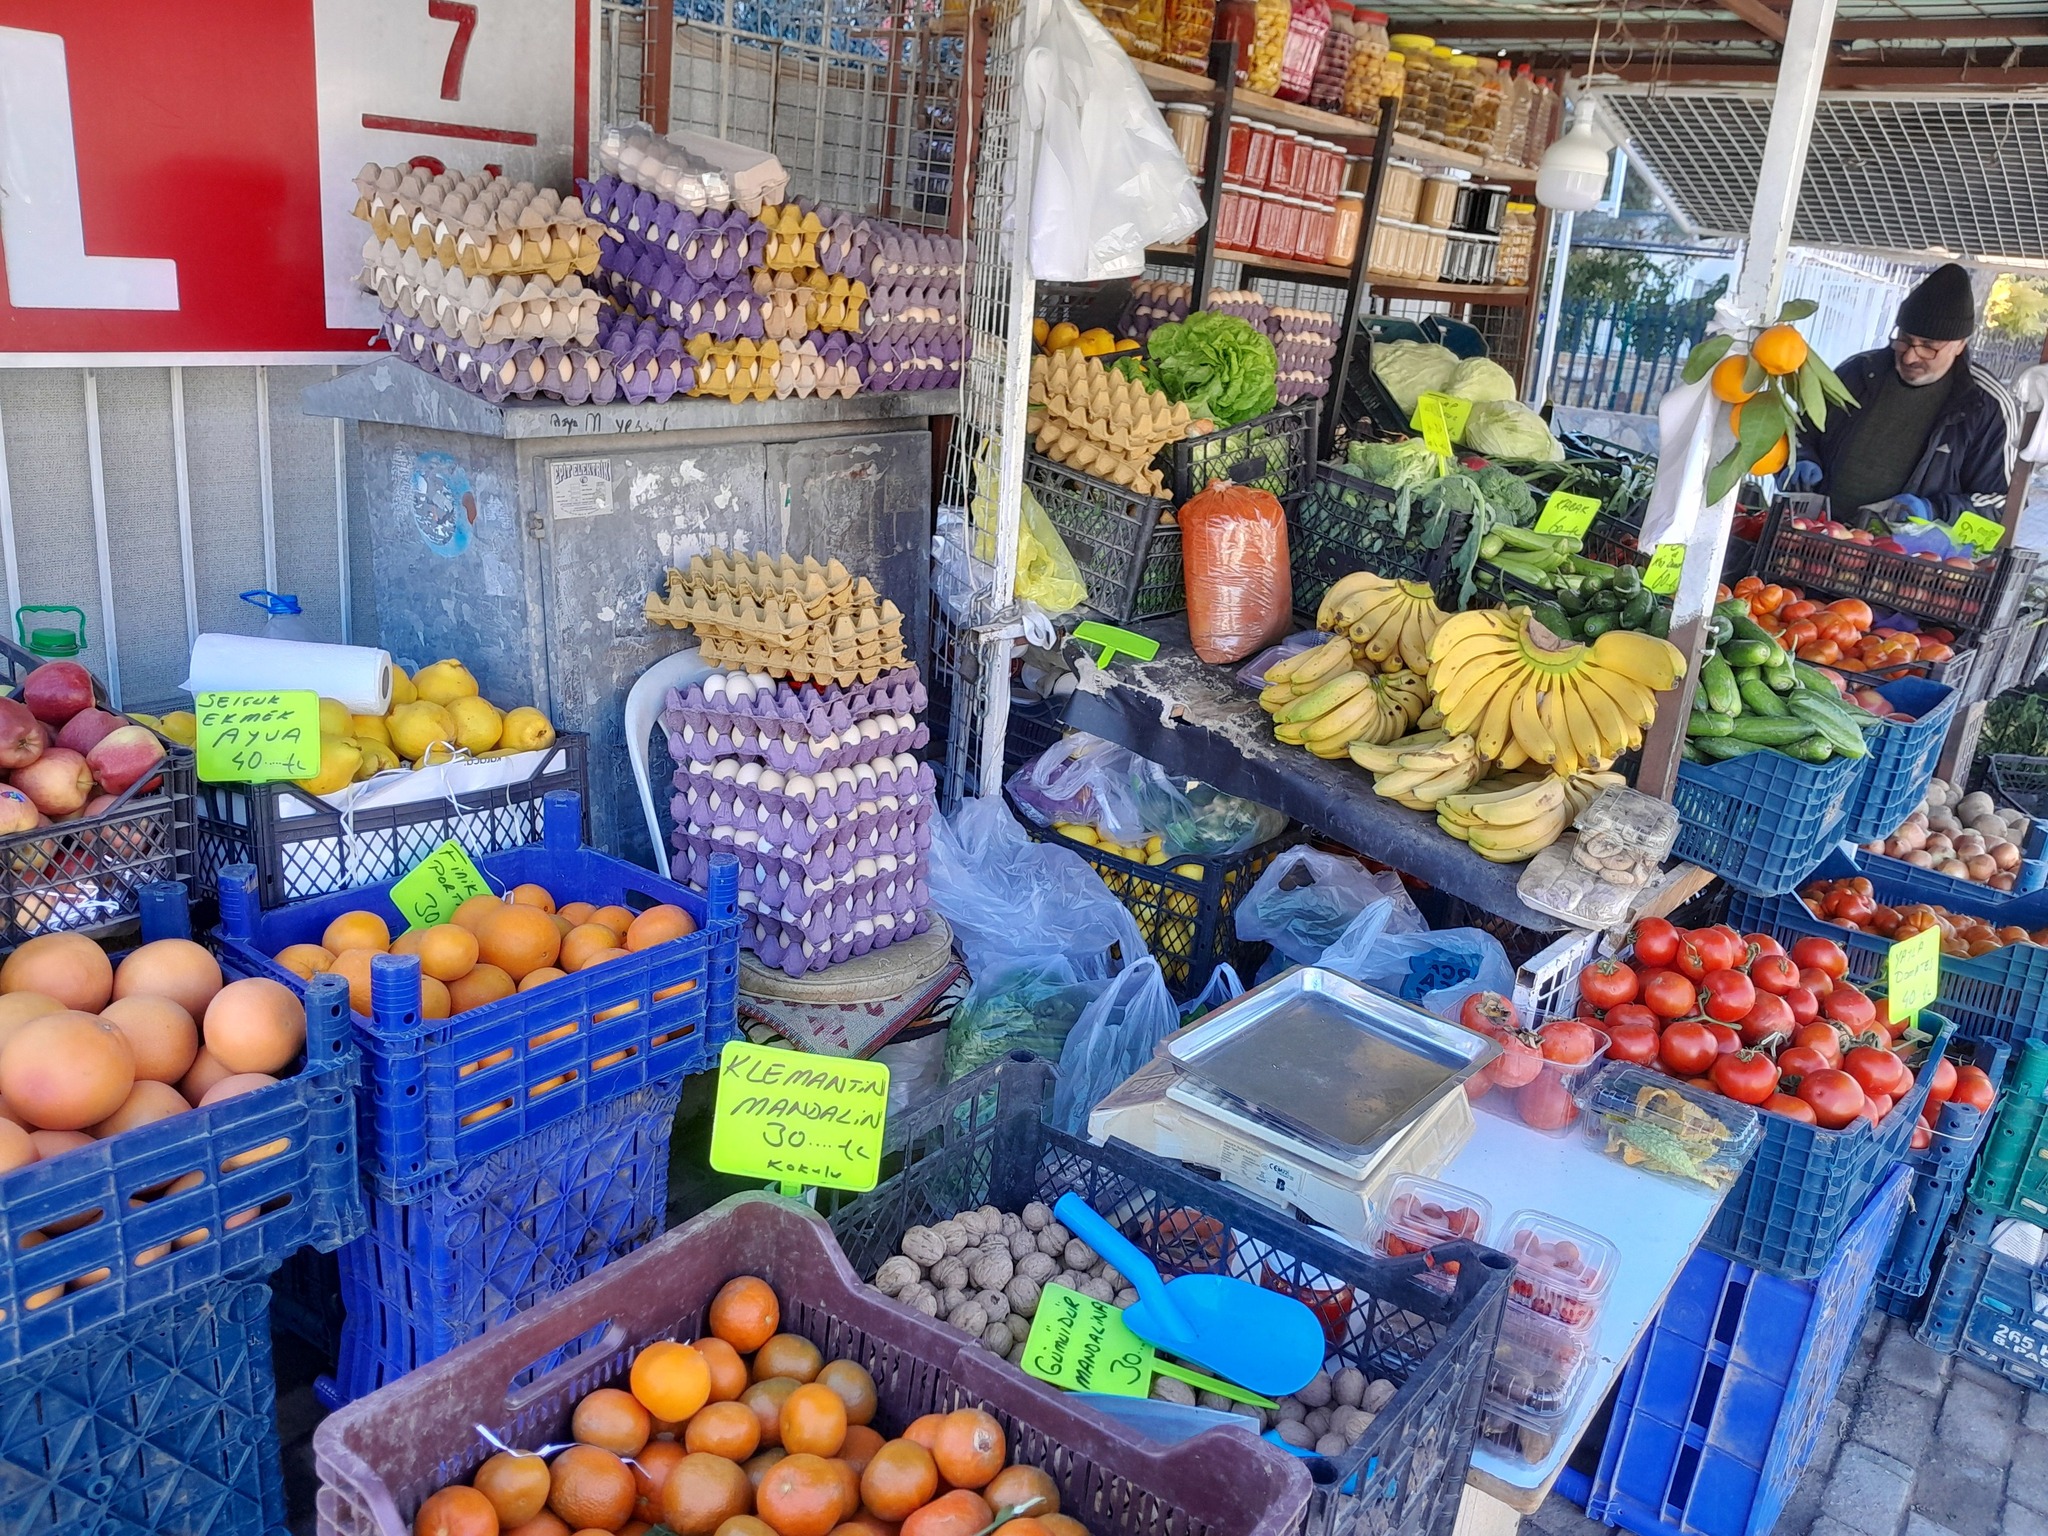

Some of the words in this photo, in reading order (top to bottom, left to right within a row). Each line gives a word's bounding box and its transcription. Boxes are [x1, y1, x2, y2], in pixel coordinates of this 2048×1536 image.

[428, 0, 479, 101] 7
[202, 710, 295, 727] EKMEK
[1995, 1323, 2036, 1350] 265
